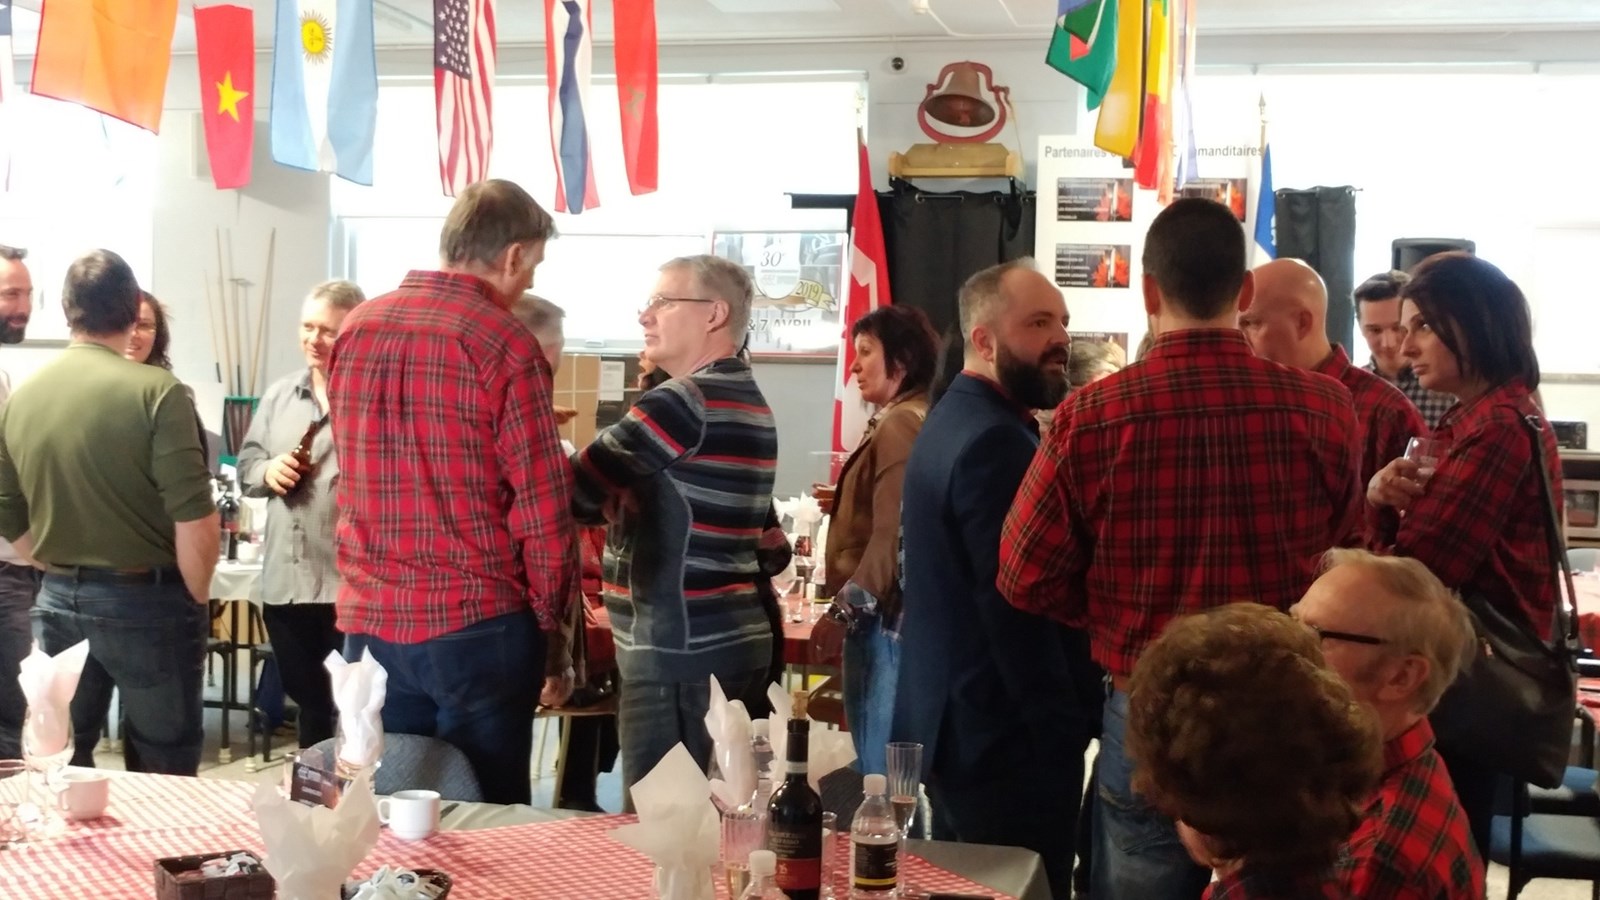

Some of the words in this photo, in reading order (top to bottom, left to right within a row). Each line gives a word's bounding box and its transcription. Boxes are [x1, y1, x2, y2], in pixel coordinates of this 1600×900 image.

[1044, 145, 1107, 158] Partenaires
[1171, 145, 1265, 157] Cmanditaires
[795, 280, 820, 299] 2019
[760, 319, 768, 331] 7
